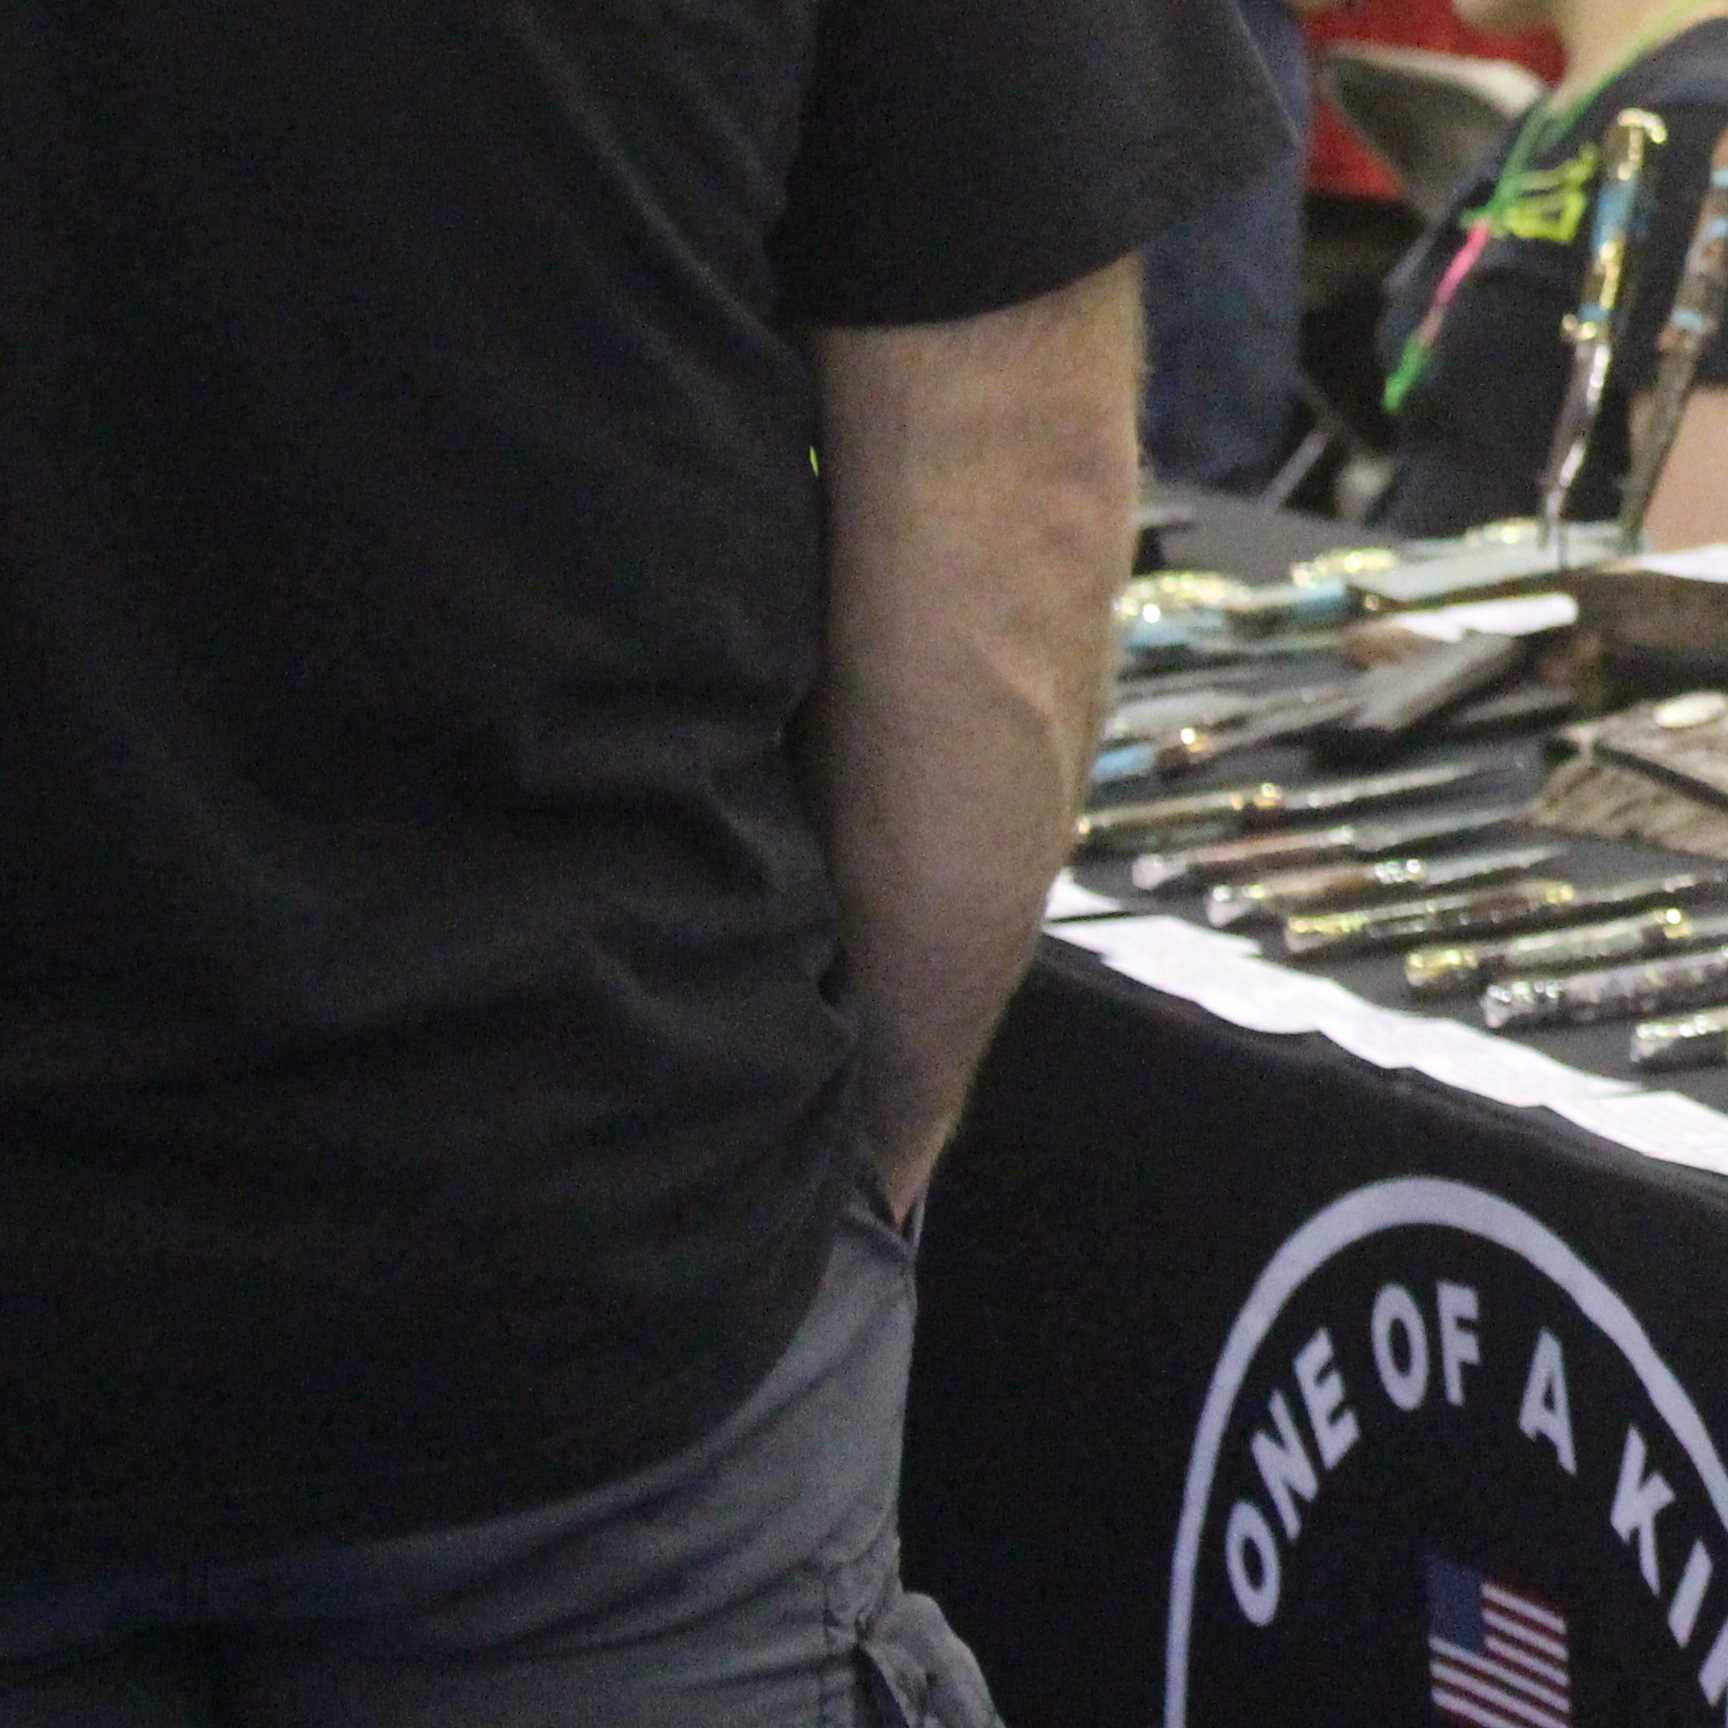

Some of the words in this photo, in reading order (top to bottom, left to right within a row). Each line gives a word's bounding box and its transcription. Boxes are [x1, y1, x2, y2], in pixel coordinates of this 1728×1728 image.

[1225, 1327, 1361, 1628] ONE
[1371, 1281, 1481, 1412] OF
[1519, 1328, 1578, 1475] A
